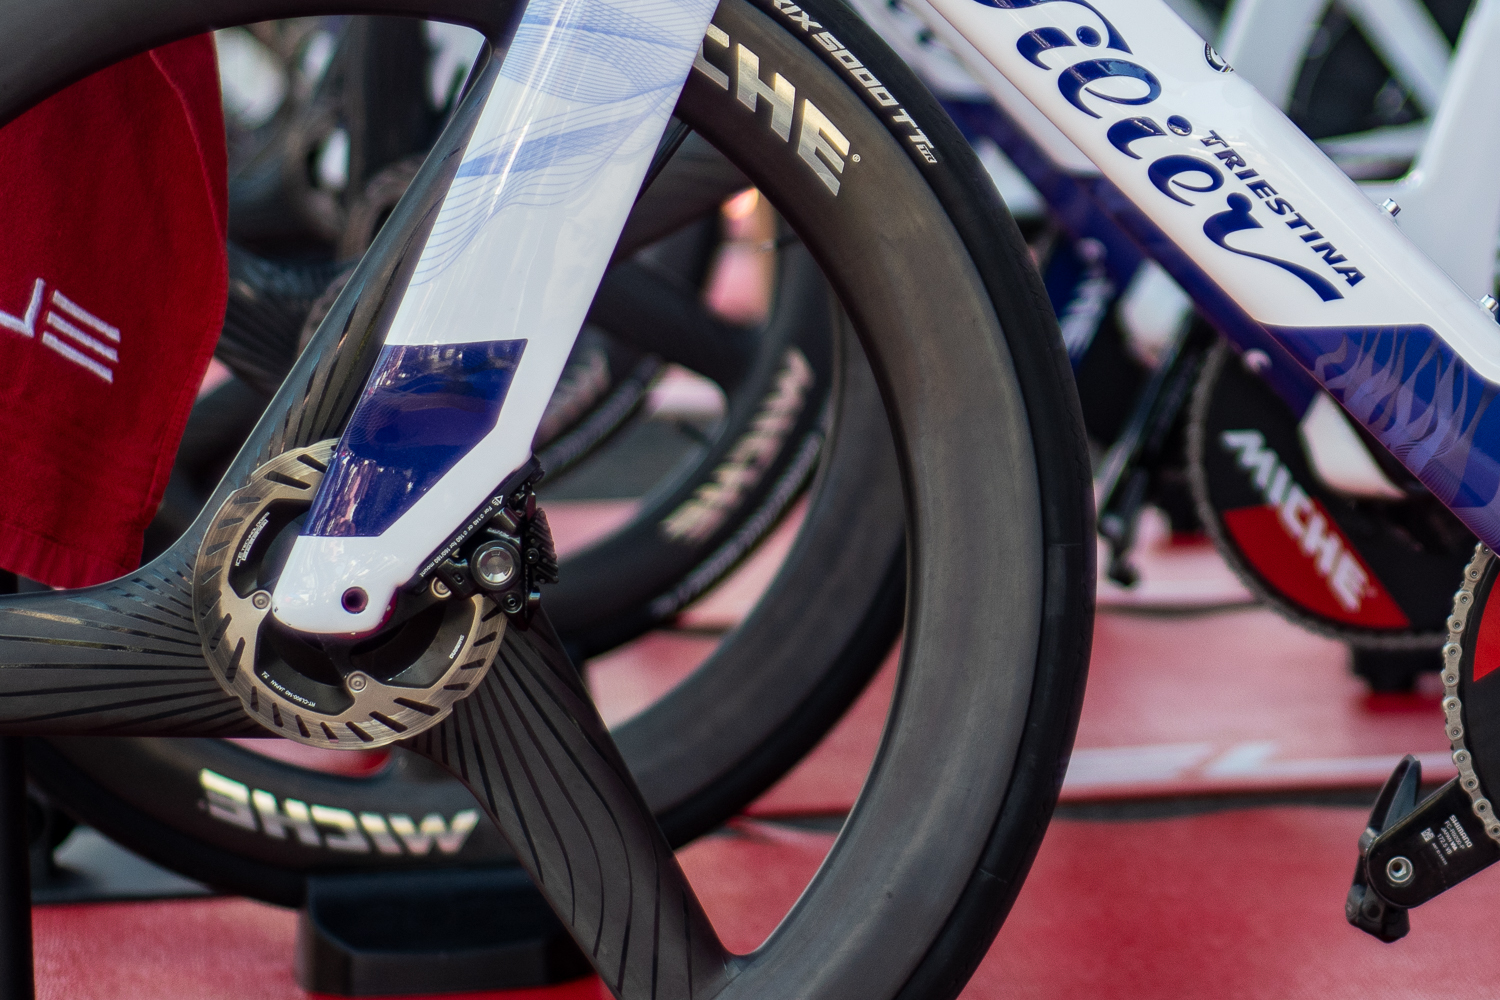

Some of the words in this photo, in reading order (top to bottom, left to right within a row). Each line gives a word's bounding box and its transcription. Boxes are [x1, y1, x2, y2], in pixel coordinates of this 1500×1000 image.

[811, 31, 900, 107] 5000
[1200, 129, 1366, 287] TRIESTINA
[1221, 429, 1368, 613] MICHE
[199, 767, 480, 856] MICHE
[1437, 833, 1449, 848] 172.5
[1449, 814, 1473, 848] SHIMANO
